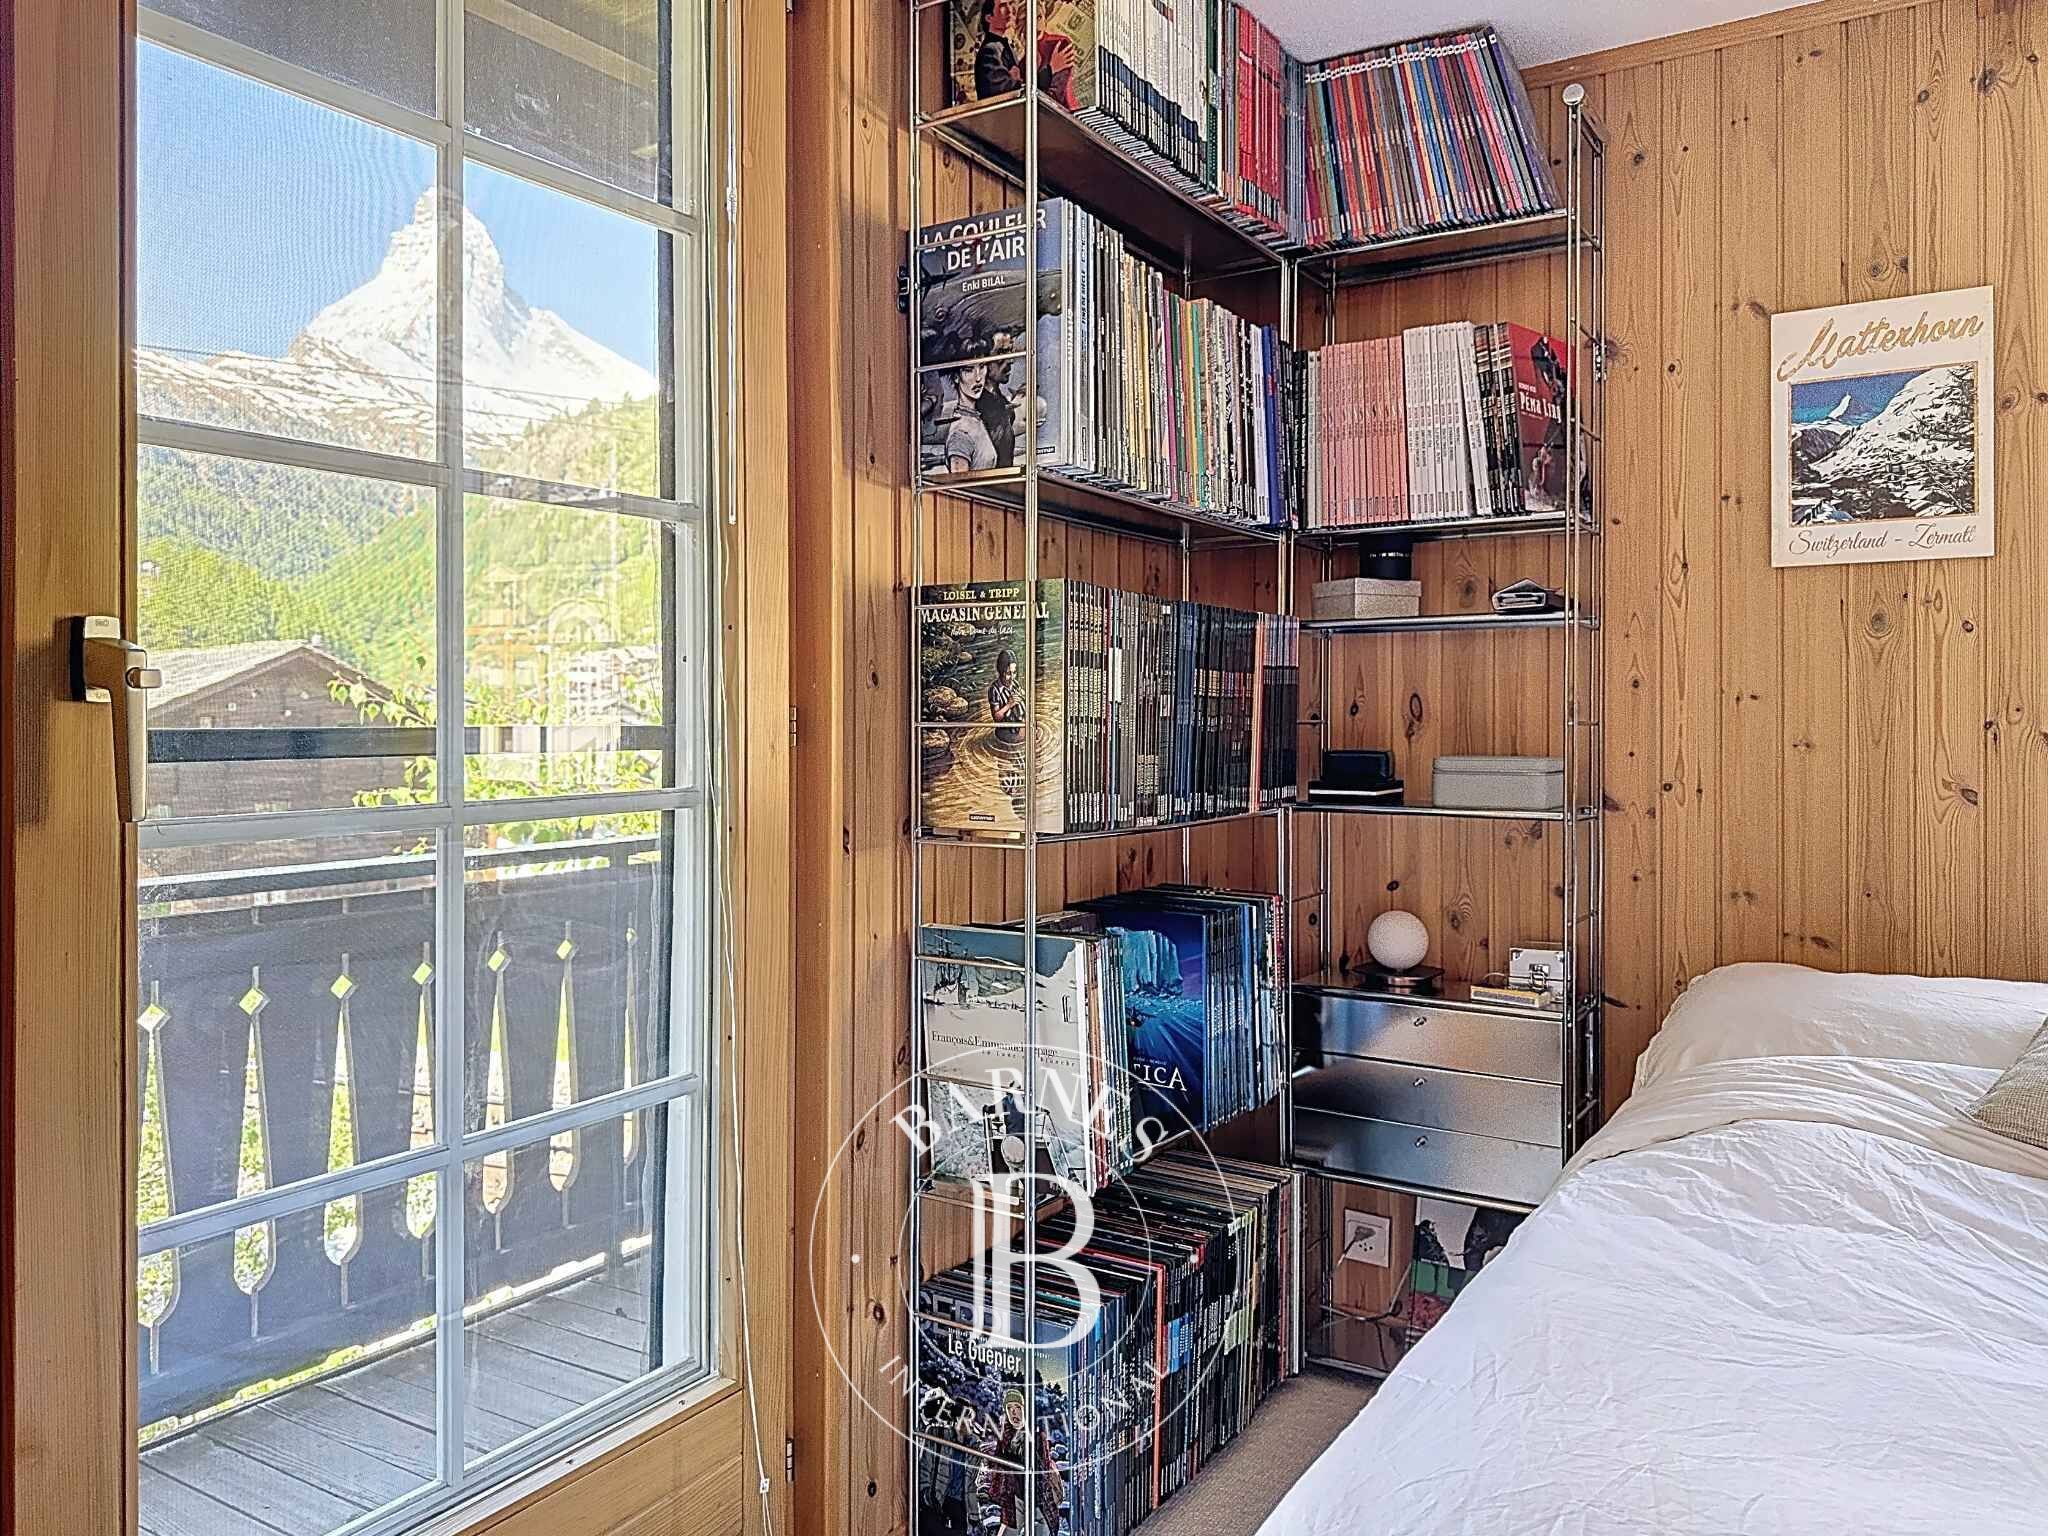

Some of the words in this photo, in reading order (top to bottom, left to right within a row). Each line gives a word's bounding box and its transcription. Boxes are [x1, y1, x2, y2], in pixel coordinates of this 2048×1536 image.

[947, 247, 972, 271] DE
[982, 275, 1006, 288] BILAL
[1776, 311, 1984, 382] Matterhorn
[1788, 529, 1889, 559] Switzerland
[1908, 523, 1977, 549] Zermatt
[944, 590, 977, 601] LOISEL
[989, 588, 1020, 599] TRIPP
[984, 601, 1050, 621] GENEL
[948, 1333, 963, 1357] Le
[967, 1338, 1022, 1373] Guêpier
